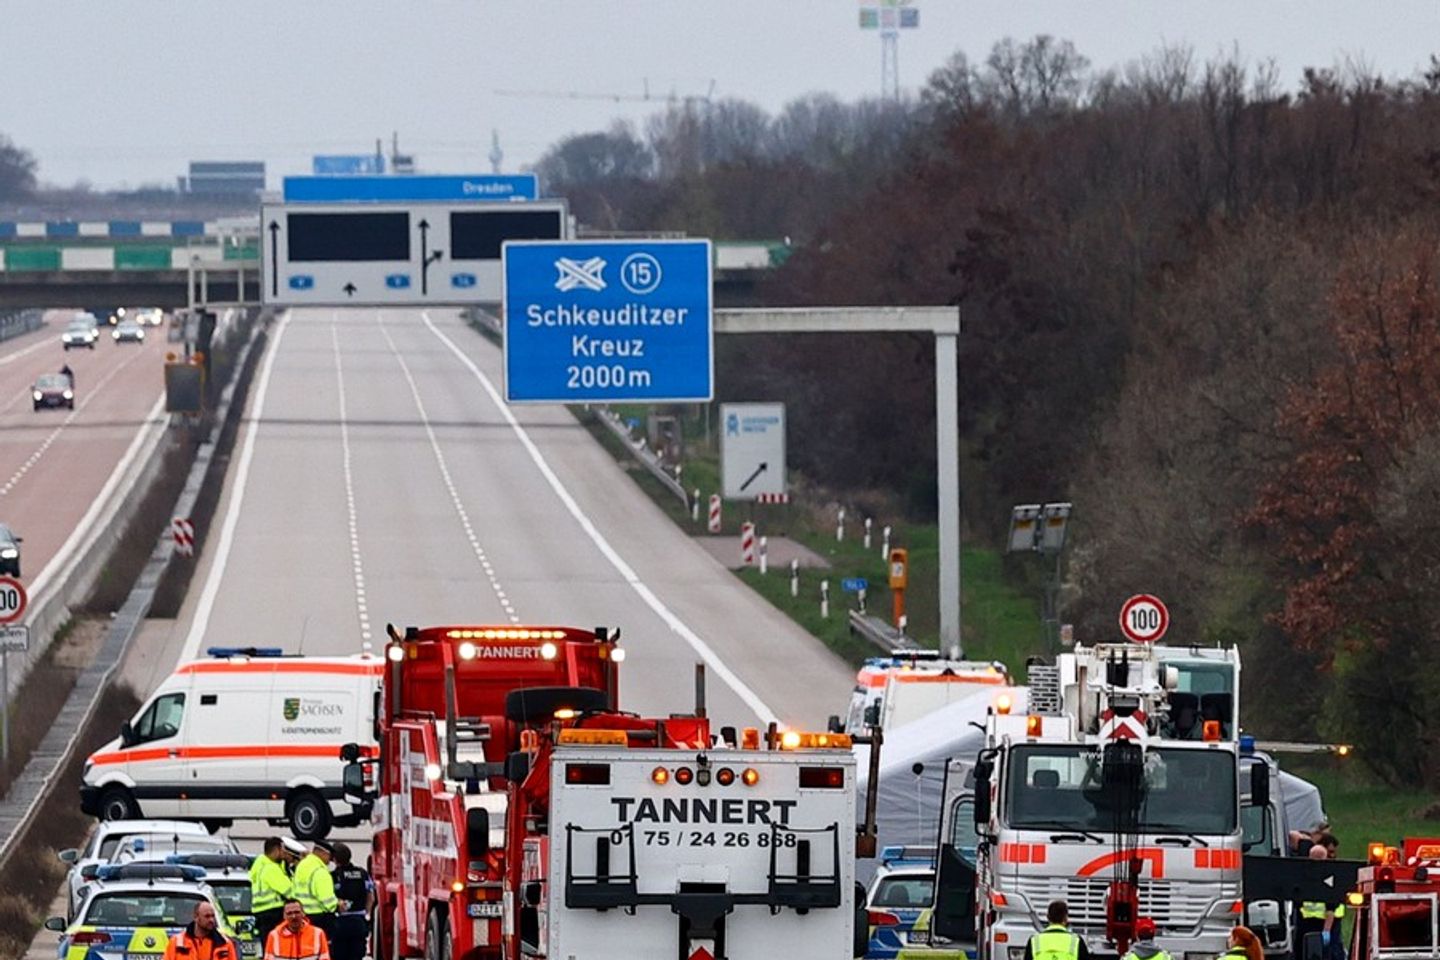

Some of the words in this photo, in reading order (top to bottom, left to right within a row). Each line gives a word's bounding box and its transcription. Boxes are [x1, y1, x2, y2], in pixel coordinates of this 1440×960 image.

[462, 181, 513, 195] Dresden
[630, 262, 651, 285] 15
[527, 304, 688, 326] Schkeuditzer
[572, 335, 644, 357] Kreuz
[567, 365, 625, 388] 2000
[629, 370, 651, 387] m
[1131, 608, 1158, 630] 100
[475, 645, 541, 659] TANNERT
[611, 797, 797, 825] TANNERT
[644, 831, 670, 846] 75
[676, 831, 683, 846] /
[690, 831, 716, 847] 24
[724, 832, 750, 847] 26
[757, 833, 797, 848] 868
